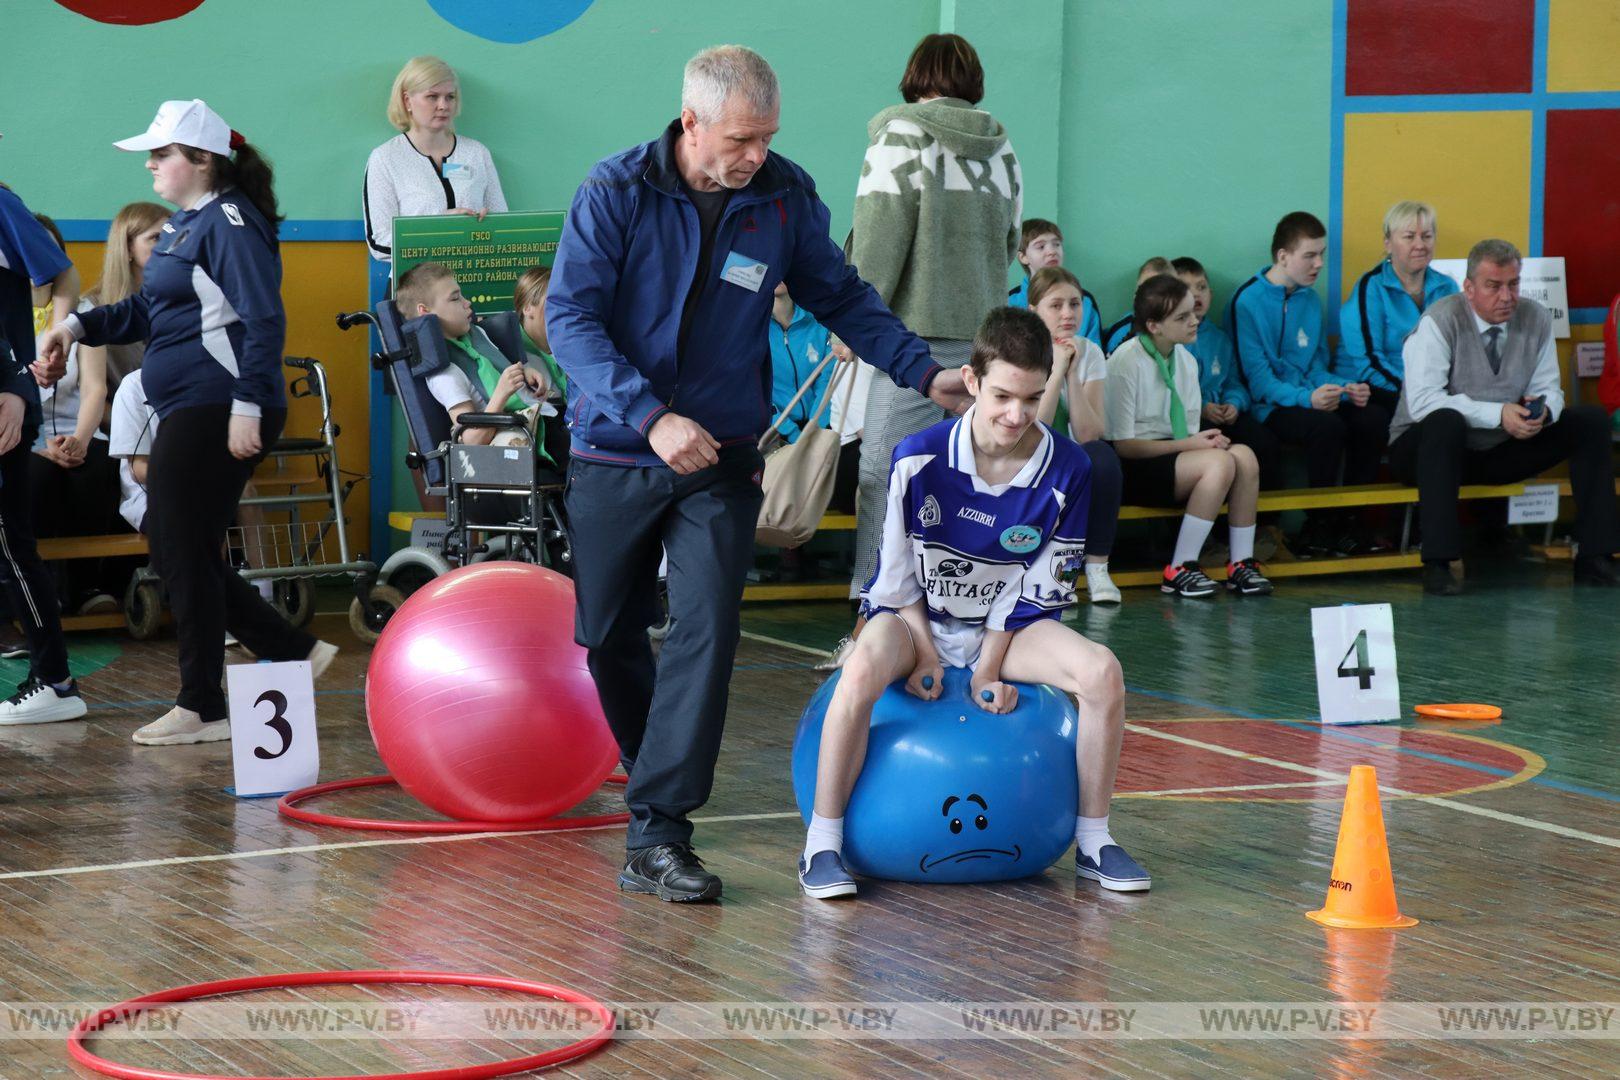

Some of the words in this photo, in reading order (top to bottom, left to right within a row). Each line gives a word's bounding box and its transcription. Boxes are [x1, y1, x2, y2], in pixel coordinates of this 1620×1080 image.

[470, 231, 491, 241] ГУСО
[401, 247, 429, 258] ЦЕНТР
[431, 244, 495, 257] КОРРЕКЦИОННО
[466, 259, 472, 269] И
[475, 256, 540, 268] РЕАБИЛИТАЦИИ
[485, 270, 518, 282] РАЙОНА
[957, 506, 996, 528] AZZURRI
[1337, 629, 1376, 690] 4
[253, 689, 293, 760] 3
